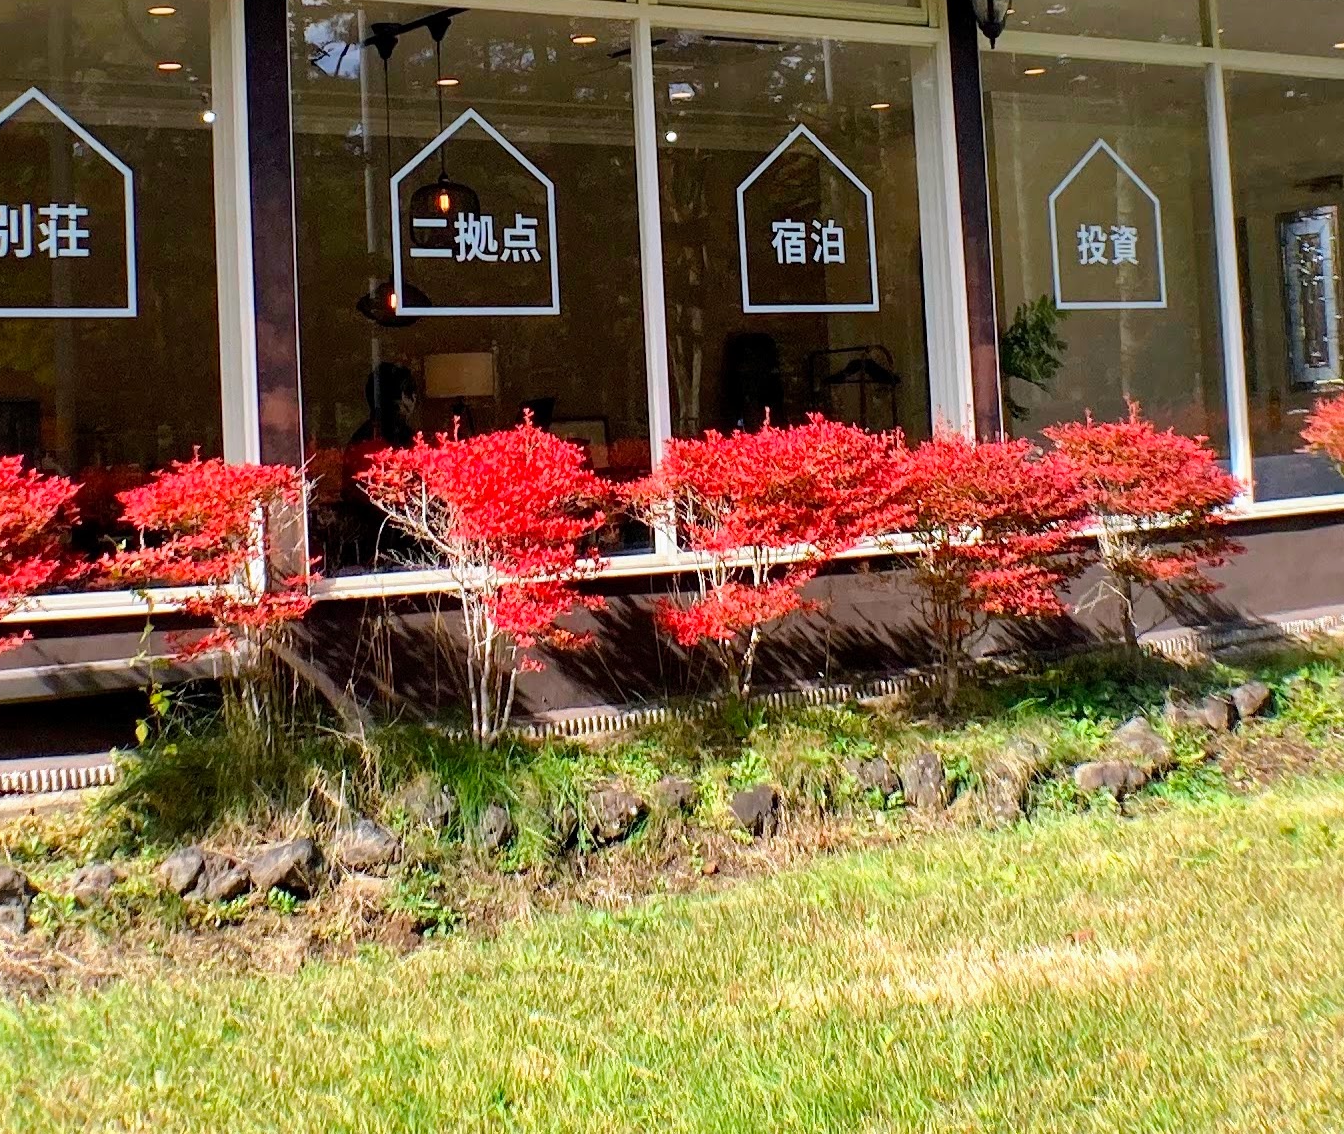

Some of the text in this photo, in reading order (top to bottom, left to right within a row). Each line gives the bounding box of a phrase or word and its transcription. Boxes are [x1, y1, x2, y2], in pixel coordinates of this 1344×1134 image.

[409, 212, 542, 264] 二拠点
[770, 218, 846, 265] 宿泊
[1075, 222, 1140, 267] 投資
